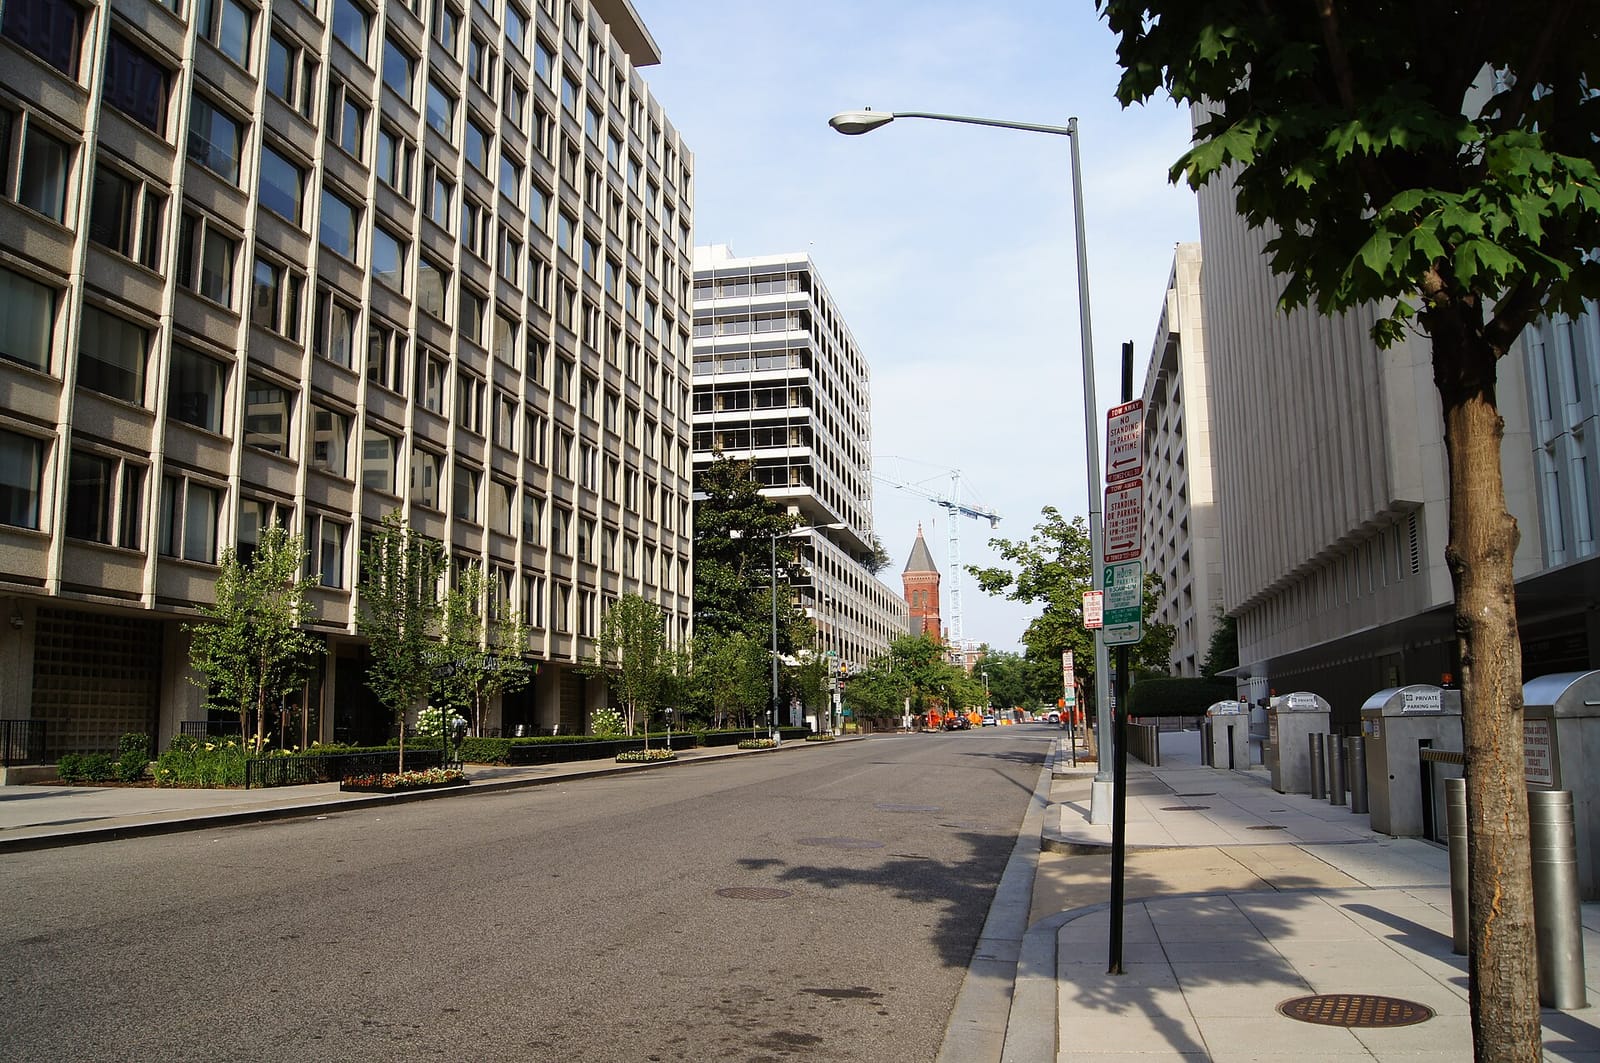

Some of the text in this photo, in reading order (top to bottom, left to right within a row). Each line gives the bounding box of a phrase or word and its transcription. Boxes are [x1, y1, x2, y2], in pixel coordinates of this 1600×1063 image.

[1112, 403, 1139, 416] TOW AWAY
[1120, 416, 1130, 424] NO
[1110, 422, 1138, 436] STANDING
[1117, 431, 1138, 444] PARKING
[1114, 441, 1136, 454] ANYTIME
[1124, 481, 1138, 489] AWAY
[1111, 498, 1136, 511] STANDING
[1108, 506, 1140, 520] OR PARKING
[1106, 568, 1112, 584] 2
